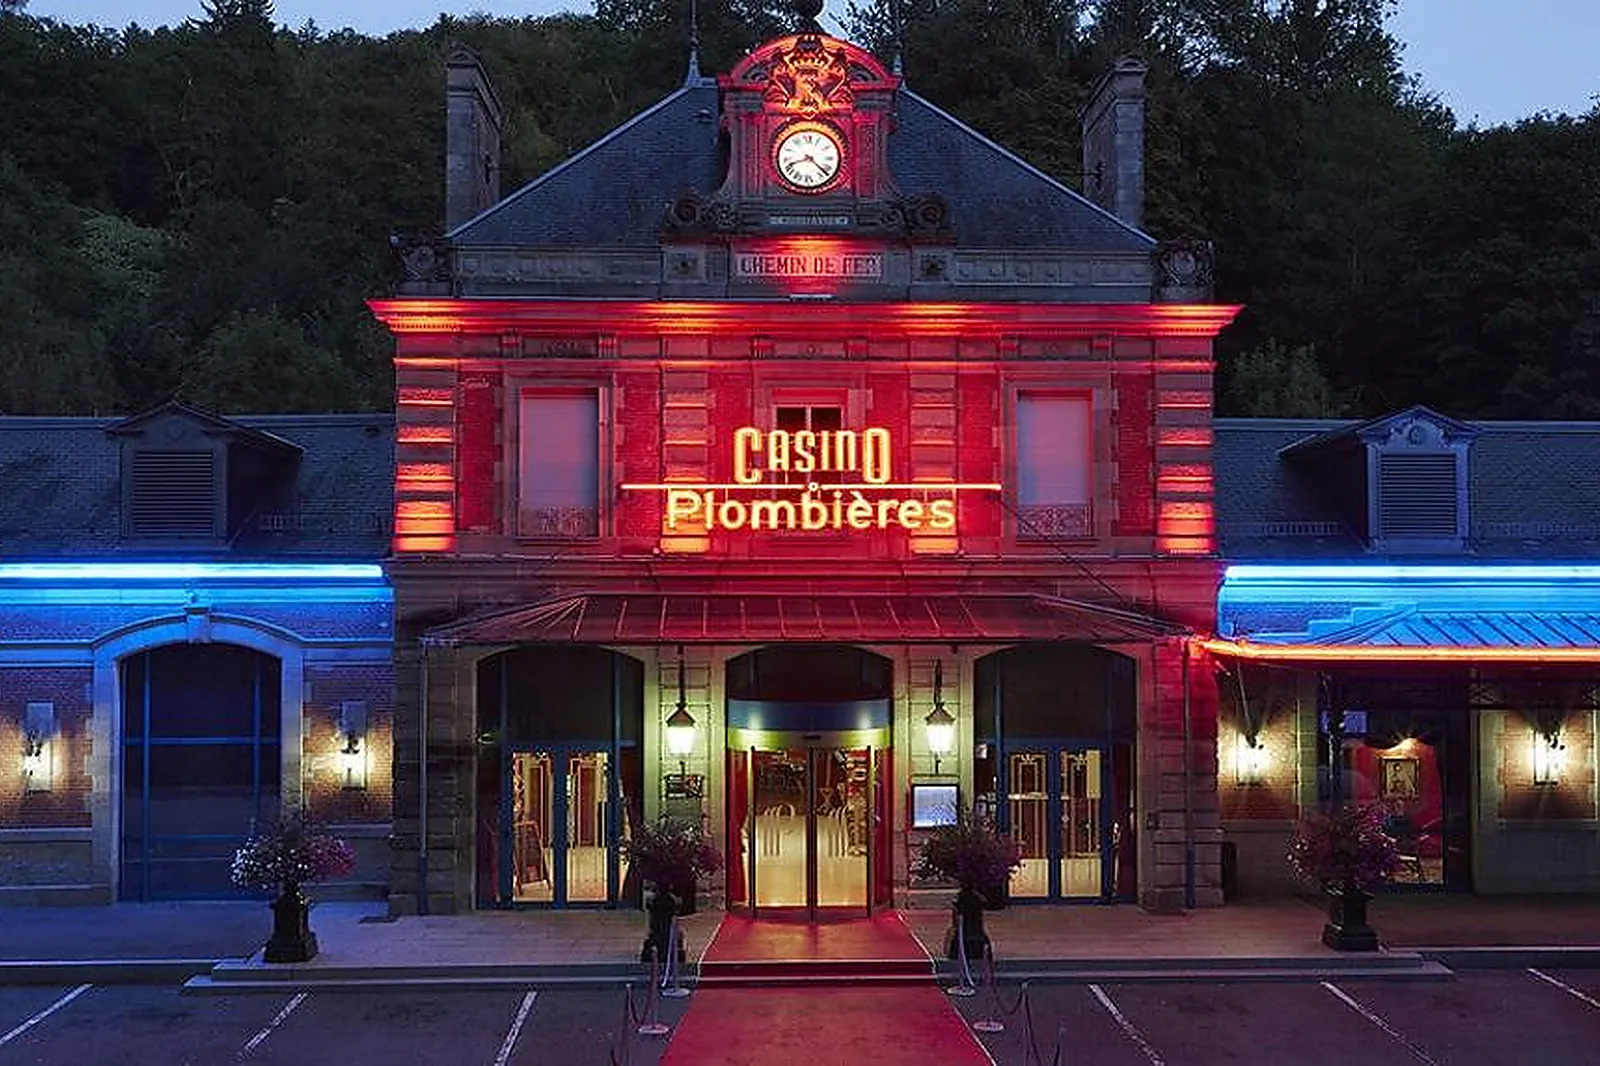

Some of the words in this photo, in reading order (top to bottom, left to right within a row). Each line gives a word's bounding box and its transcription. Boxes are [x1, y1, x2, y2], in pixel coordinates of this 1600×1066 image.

[741, 257, 807, 273] CHEMIN
[813, 257, 837, 273] DE
[666, 489, 957, 530] Plombières
